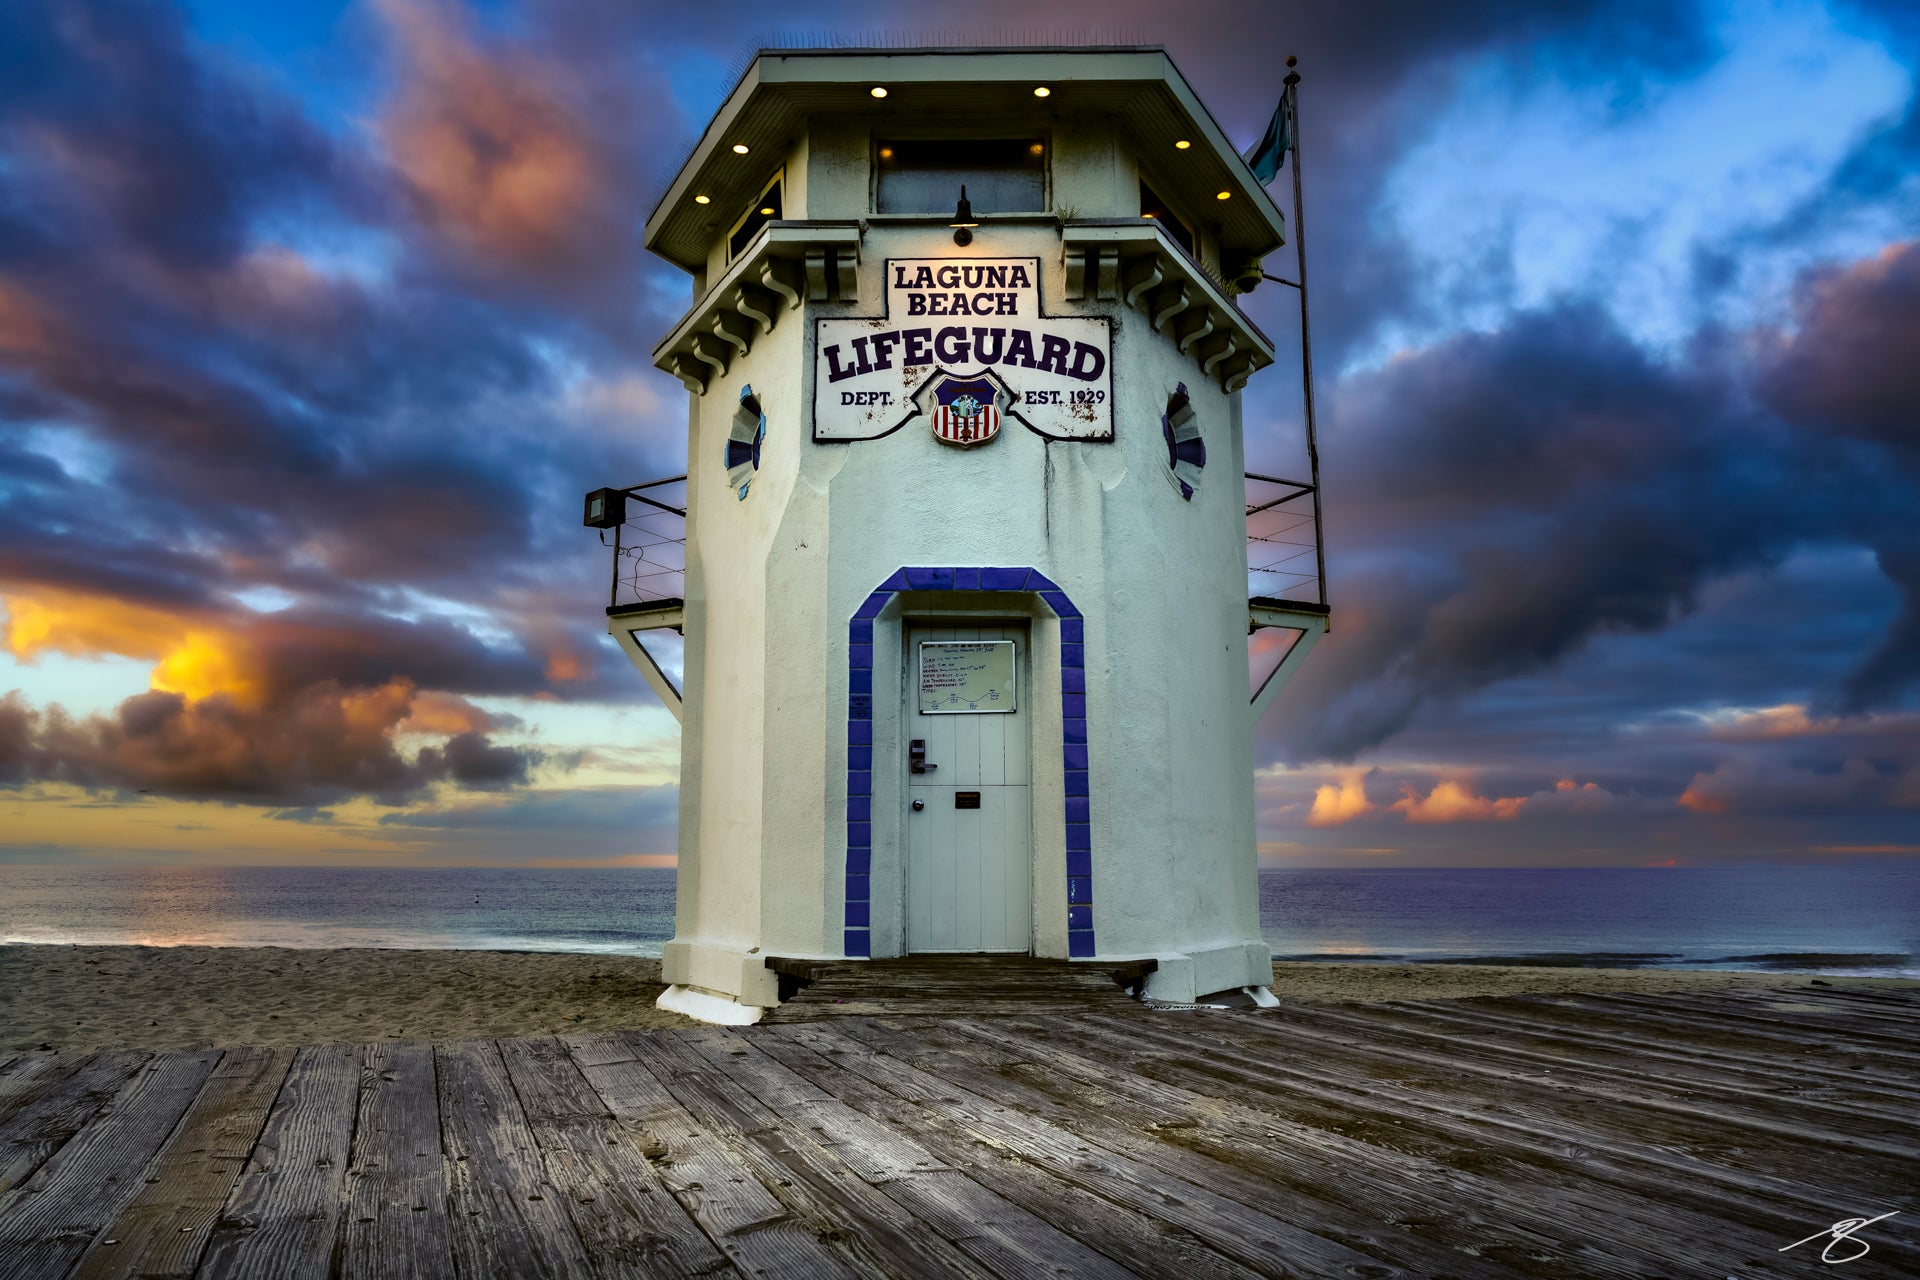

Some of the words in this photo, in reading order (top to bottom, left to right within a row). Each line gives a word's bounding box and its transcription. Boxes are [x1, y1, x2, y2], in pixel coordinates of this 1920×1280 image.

[894, 265, 1031, 289] LAGUNA
[907, 292, 1018, 316] BEACH
[823, 326, 1106, 383] LIFEGUARD
[840, 391, 893, 406] DEPT.
[1025, 390, 1063, 405] EST.
[1069, 389, 1106, 405] 1929
